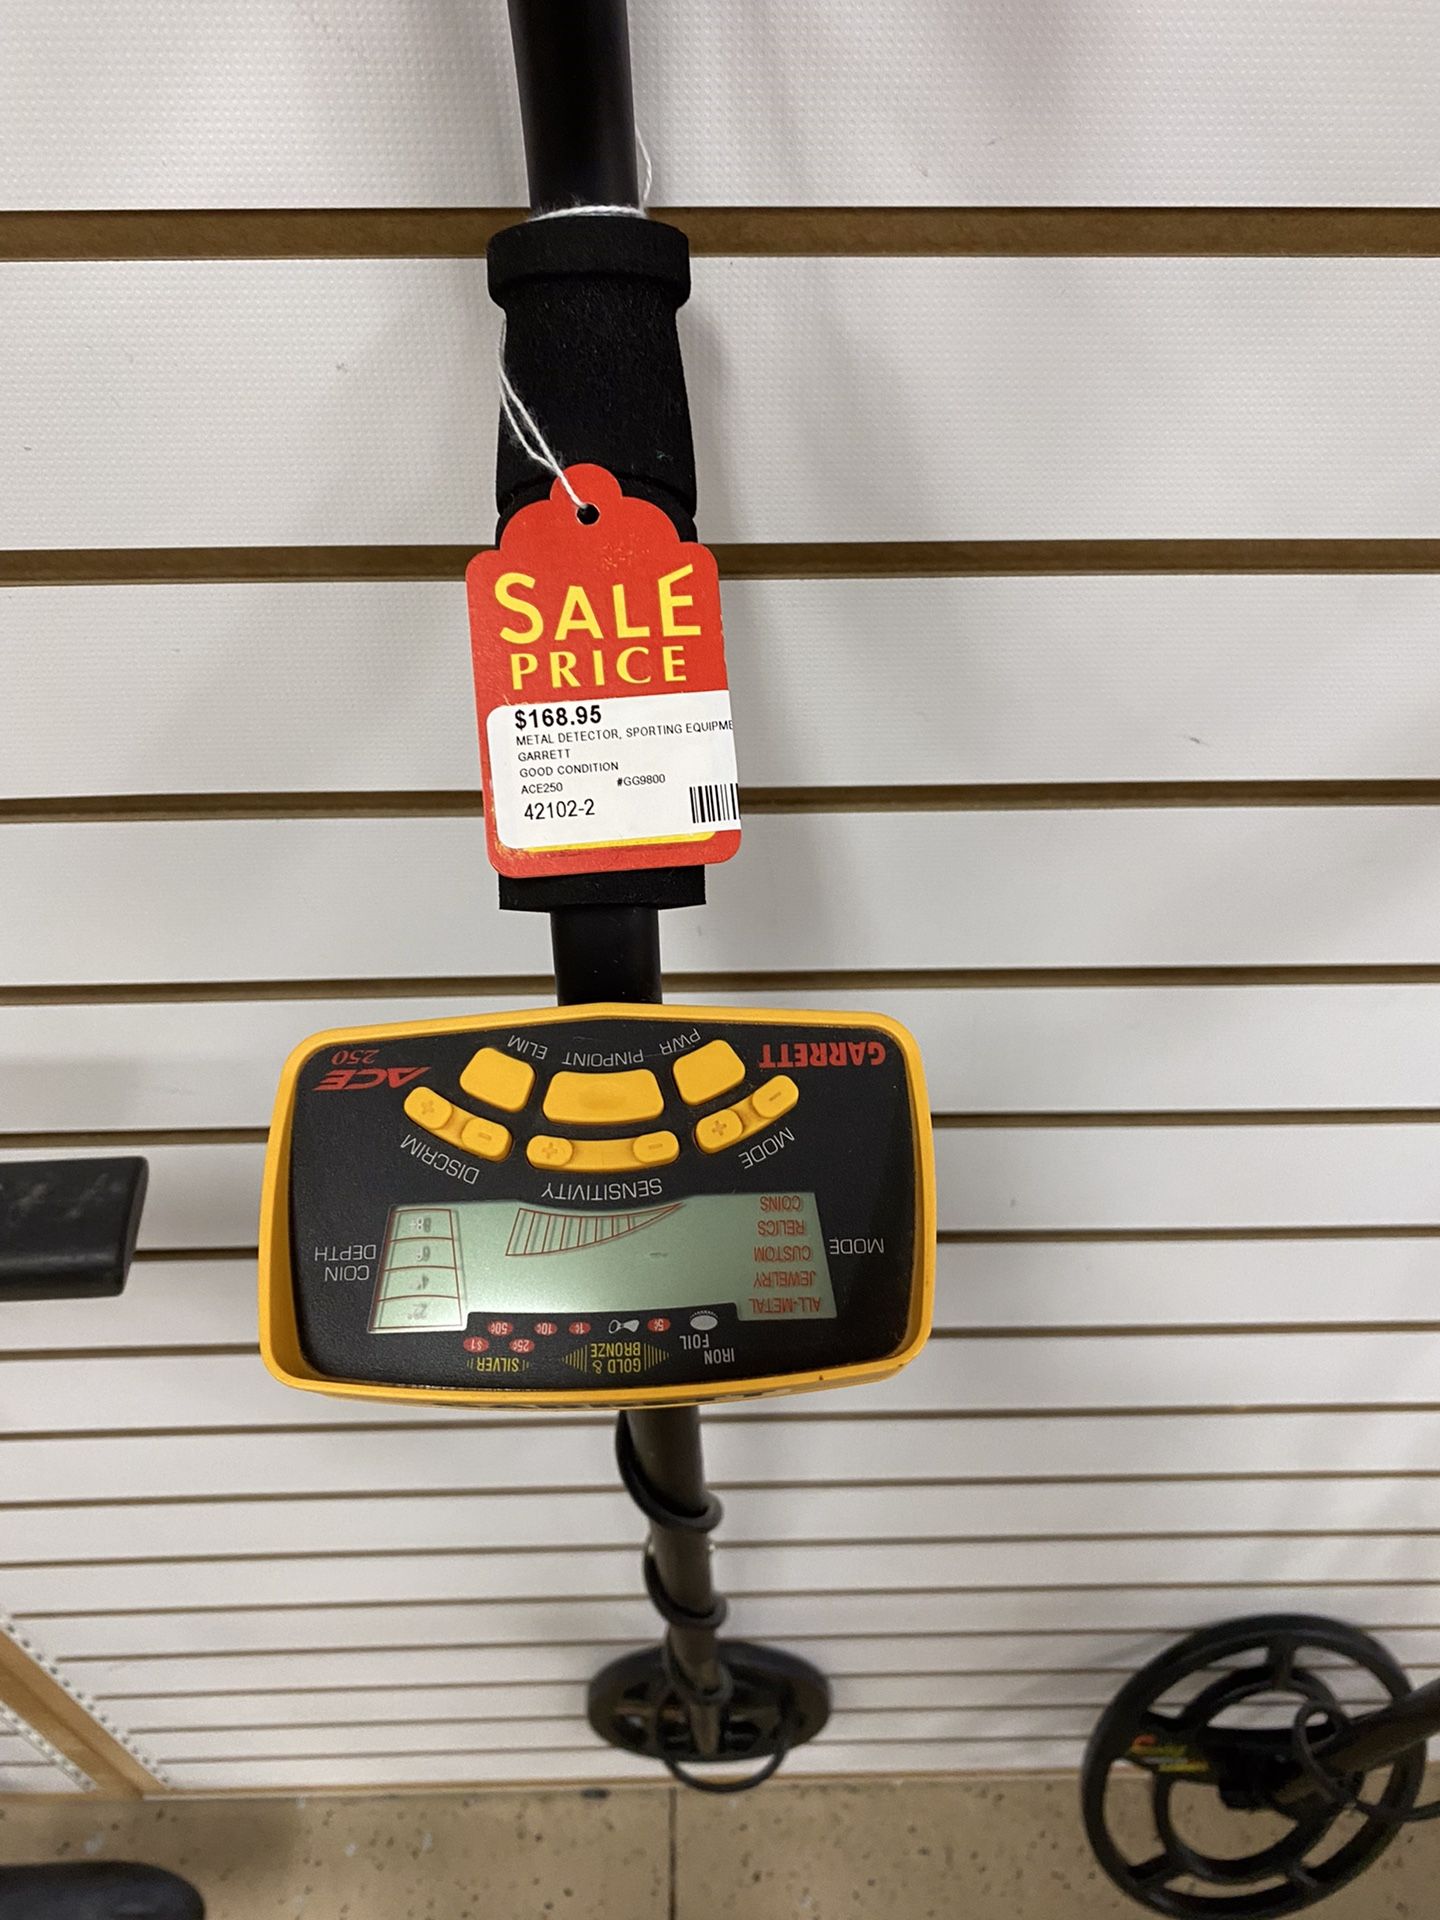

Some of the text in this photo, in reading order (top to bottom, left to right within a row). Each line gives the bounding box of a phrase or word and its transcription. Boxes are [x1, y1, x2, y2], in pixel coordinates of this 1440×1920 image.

[494, 563, 702, 645] SALE
[510, 645, 687, 690] PRICE
[514, 704, 602, 730] $168.95
[516, 731, 554, 747] METAL
[558, 728, 623, 744] DETECTOR,
[626, 723, 683, 738] SPORTING
[518, 748, 571, 762] GARRETT
[519, 761, 619, 778] GOOD CONDITION
[521, 773, 666, 795] ACE250 #GG9800
[524, 798, 596, 821] 42102-2
[507, 1034, 549, 1061] ELIM
[659, 1027, 702, 1056] PWR
[331, 1049, 381, 1065] 250
[561, 1048, 644, 1067] PINPOINT
[759, 1041, 887, 1069] GARRETT
[312, 1066, 432, 1091] ACE
[737, 1126, 795, 1170] MODE
[400, 1133, 480, 1185] DISCRIM
[541, 1177, 663, 1201] SENSITIVITY
[759, 1195, 804, 1213] COINS
[757, 1219, 805, 1236] RELICS
[315, 1244, 377, 1262] DEPTH
[754, 1244, 811, 1262] CUSTOM
[828, 1237, 885, 1255] MODE
[324, 1265, 370, 1282] COIN
[752, 1270, 816, 1288] JEWELRY
[748, 1296, 821, 1315] ALL-METAL
[590, 1341, 642, 1358] BRONZE
[679, 1333, 710, 1351] FOIL
[476, 1356, 520, 1373] SILVER
[592, 1357, 642, 1375] GOLD &
[703, 1347, 736, 1366] IRON
